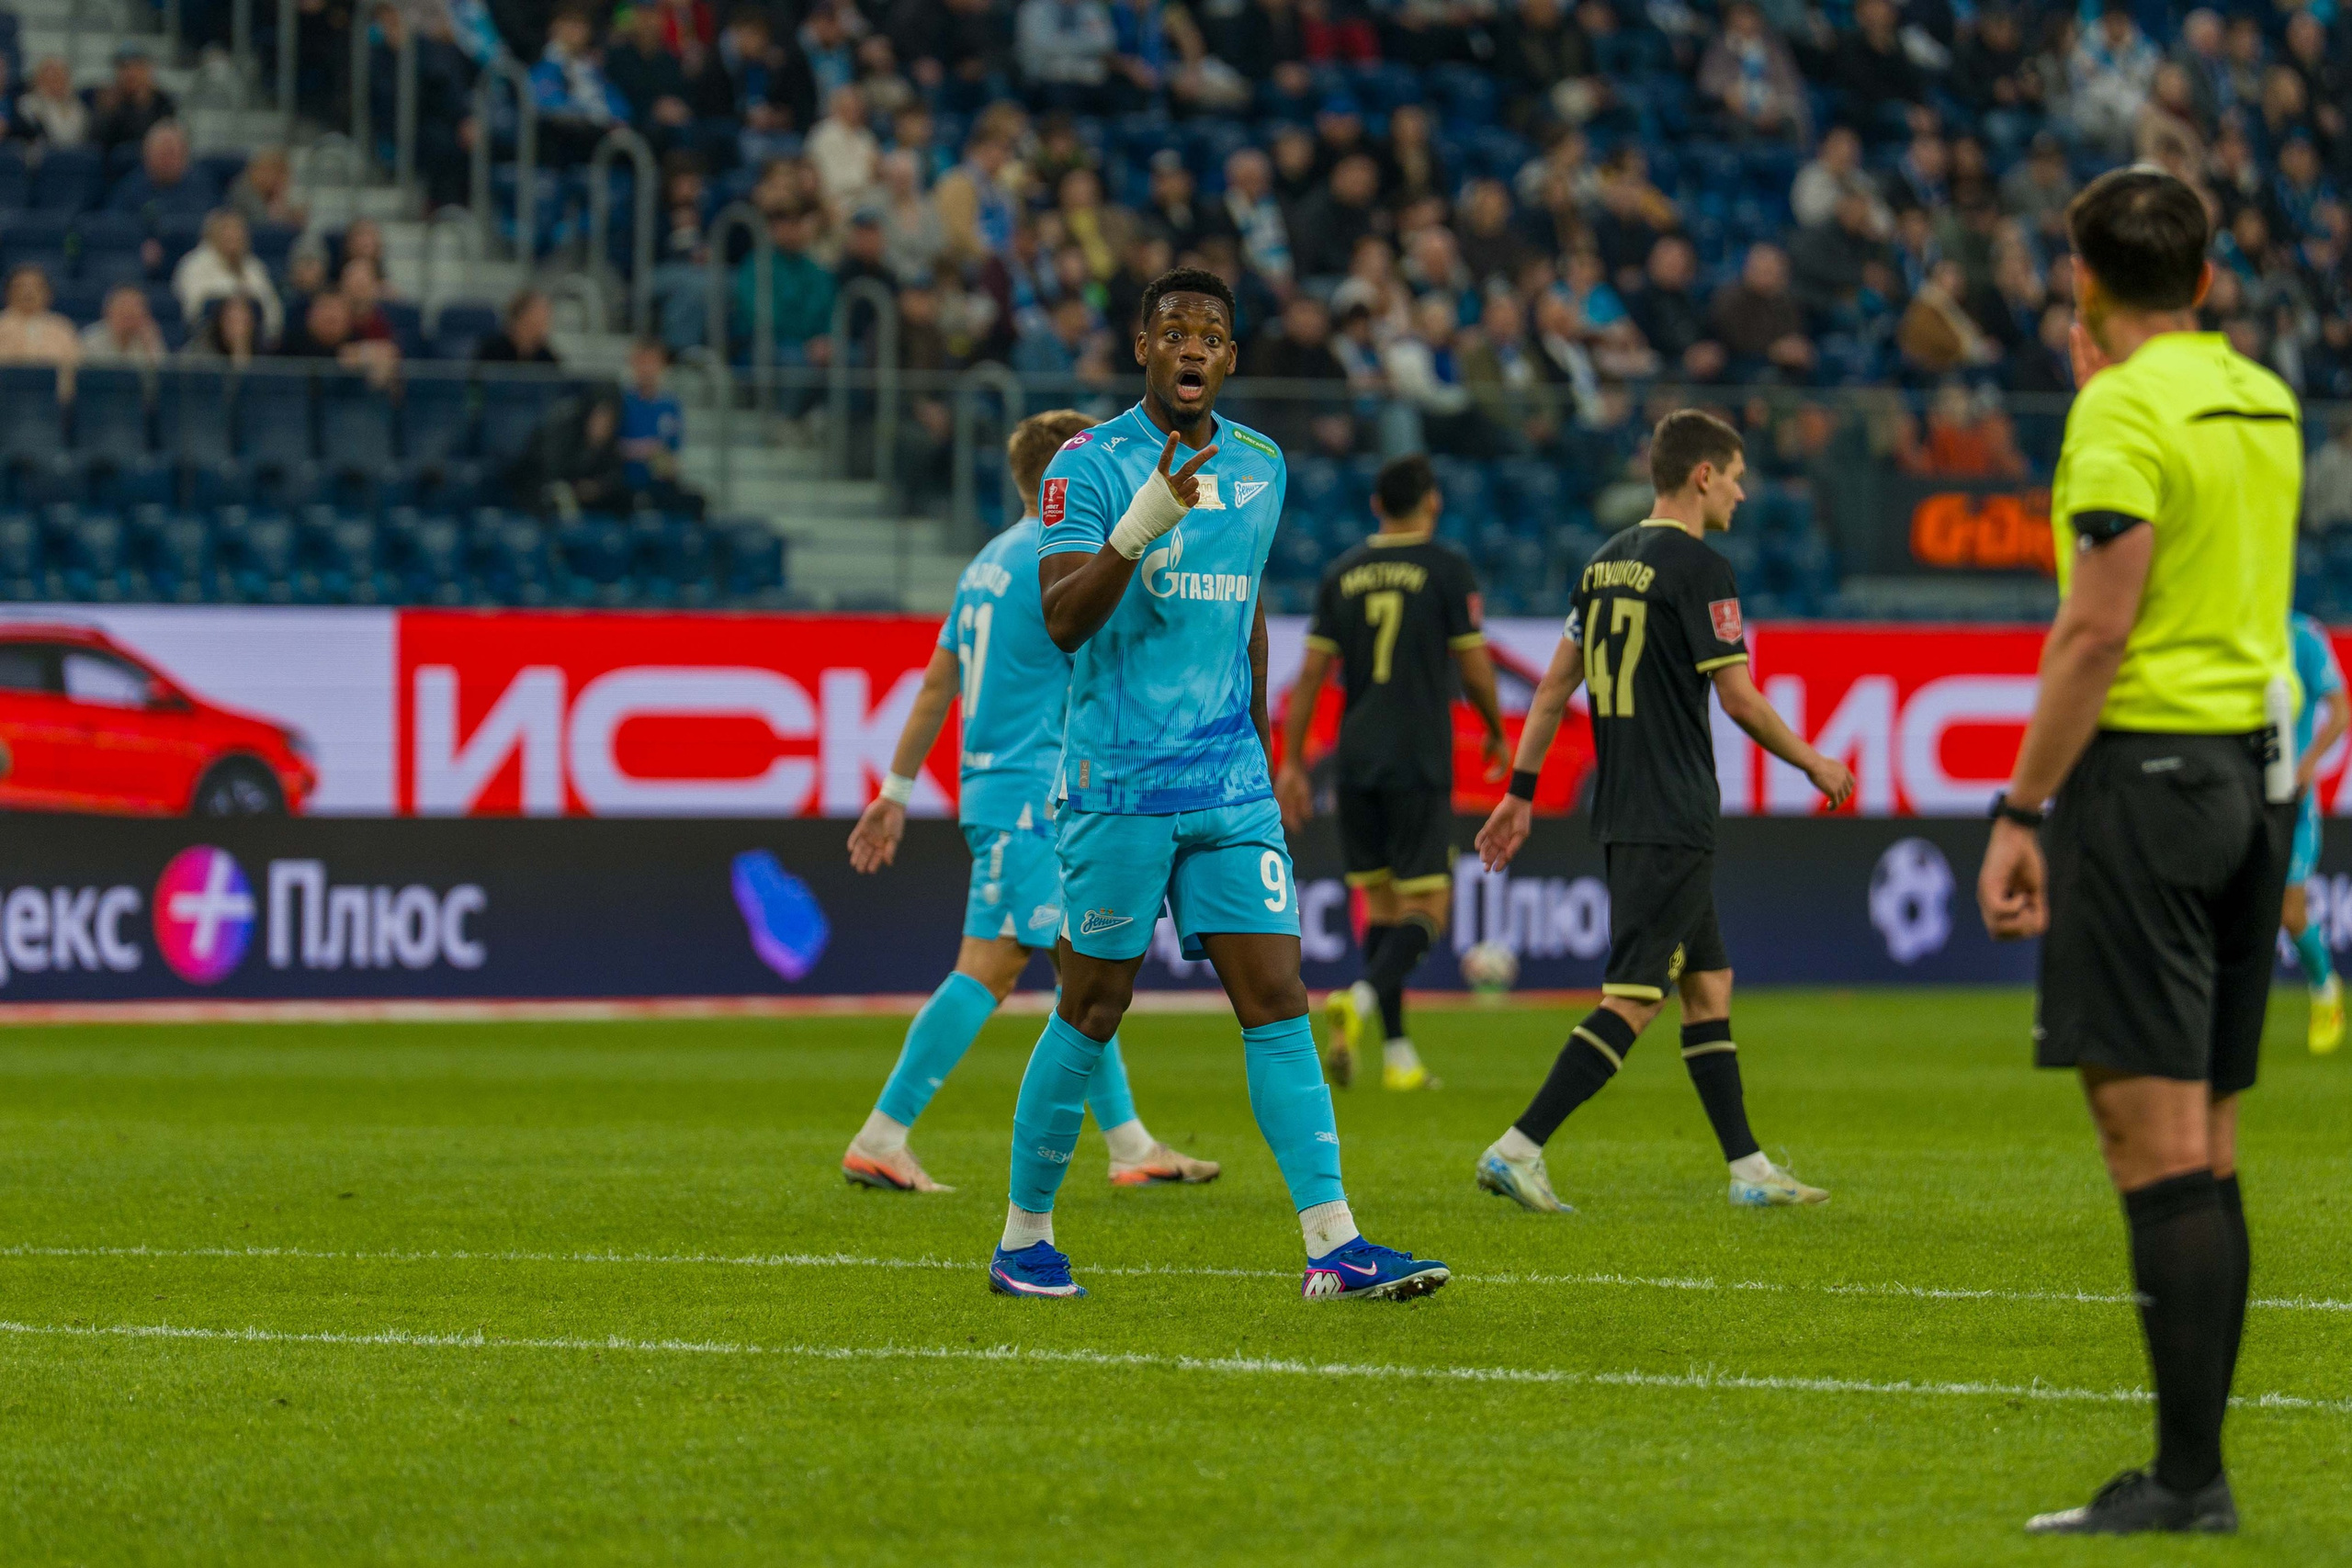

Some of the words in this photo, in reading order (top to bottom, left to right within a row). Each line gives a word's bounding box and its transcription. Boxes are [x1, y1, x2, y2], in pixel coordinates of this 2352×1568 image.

[1180, 572, 1251, 602] ГАЗПРО
[1582, 559, 1656, 593] ГЛУШКОВ
[1364, 591, 1404, 683] 7
[1583, 597, 1647, 718] 47
[0, 884, 143, 988] екс
[266, 859, 486, 968] Плюс
[1261, 851, 1287, 912] 9
[1453, 856, 1611, 961] Плю
